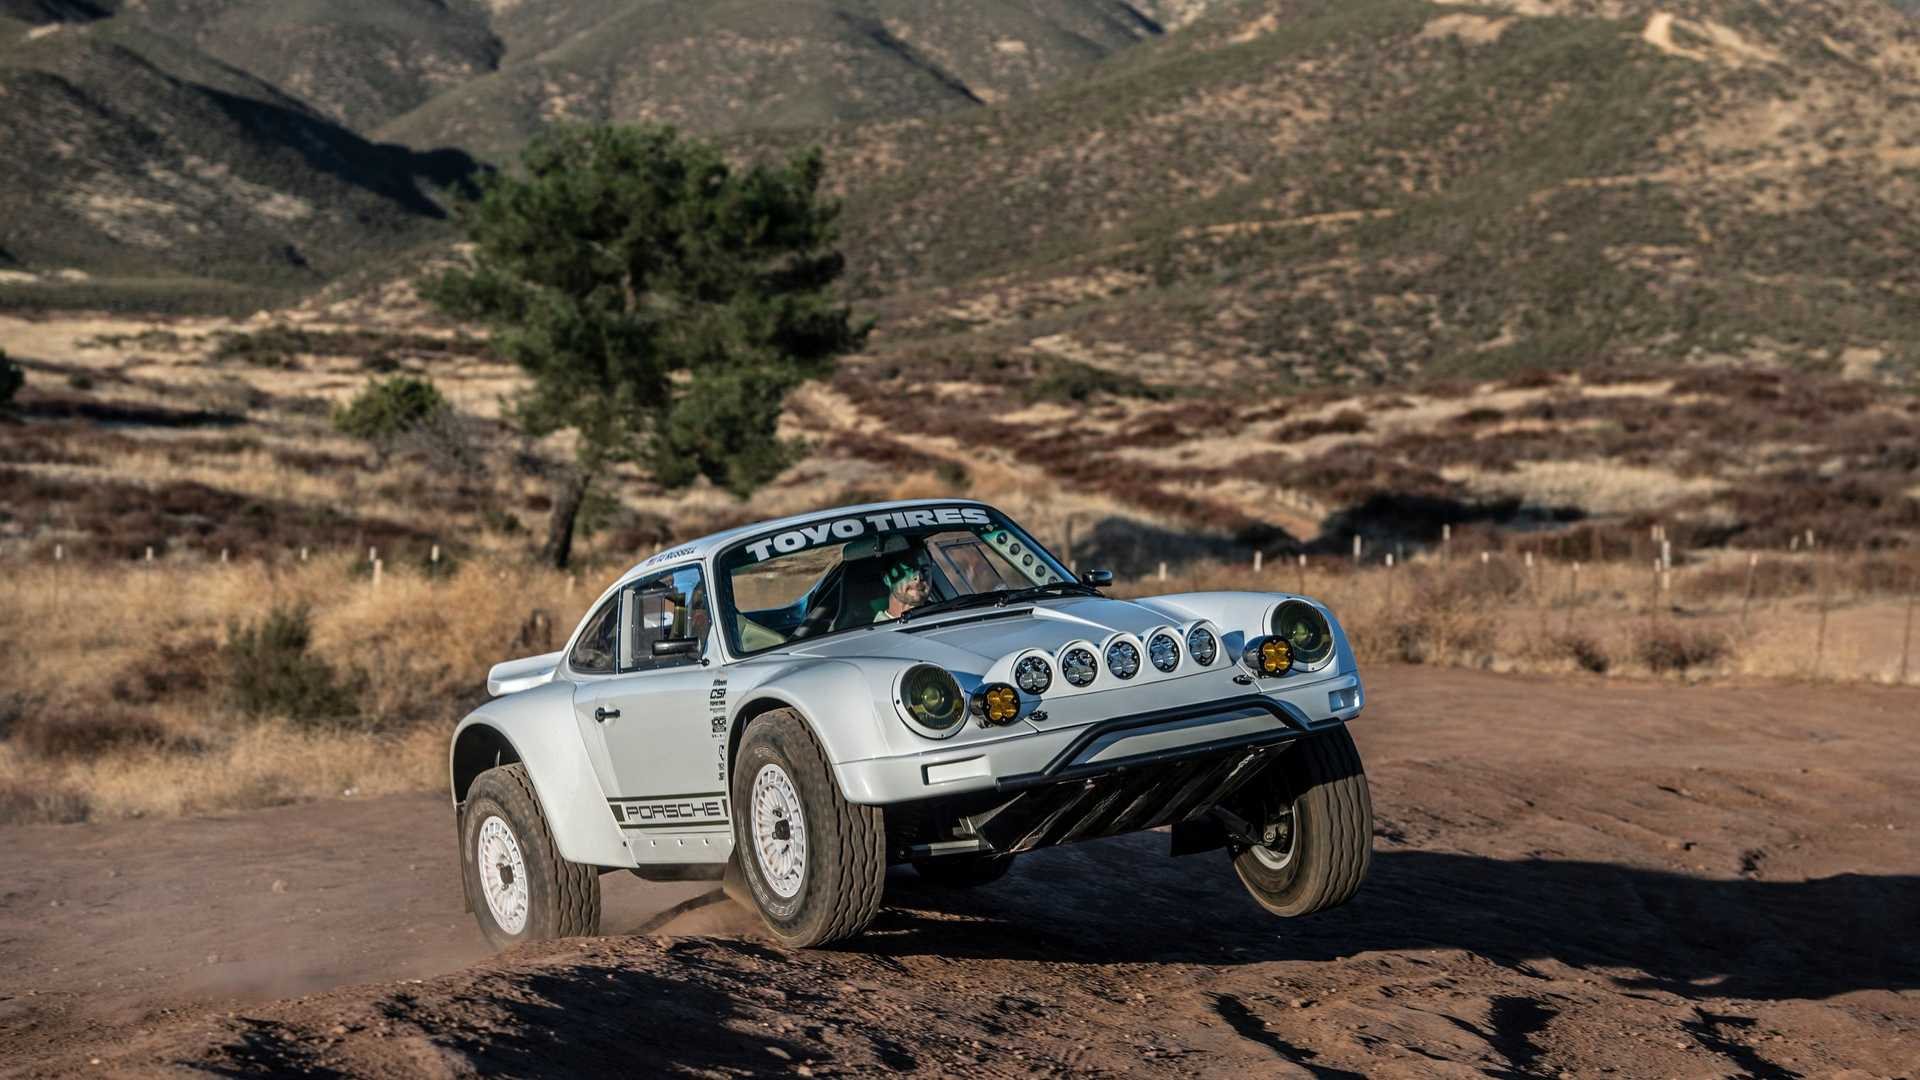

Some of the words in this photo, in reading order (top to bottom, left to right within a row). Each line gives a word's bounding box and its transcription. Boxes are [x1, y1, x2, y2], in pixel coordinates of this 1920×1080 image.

[746, 519, 864, 561] TOYO
[865, 508, 990, 532] TIRES
[626, 801, 721, 820] PORSCHE
